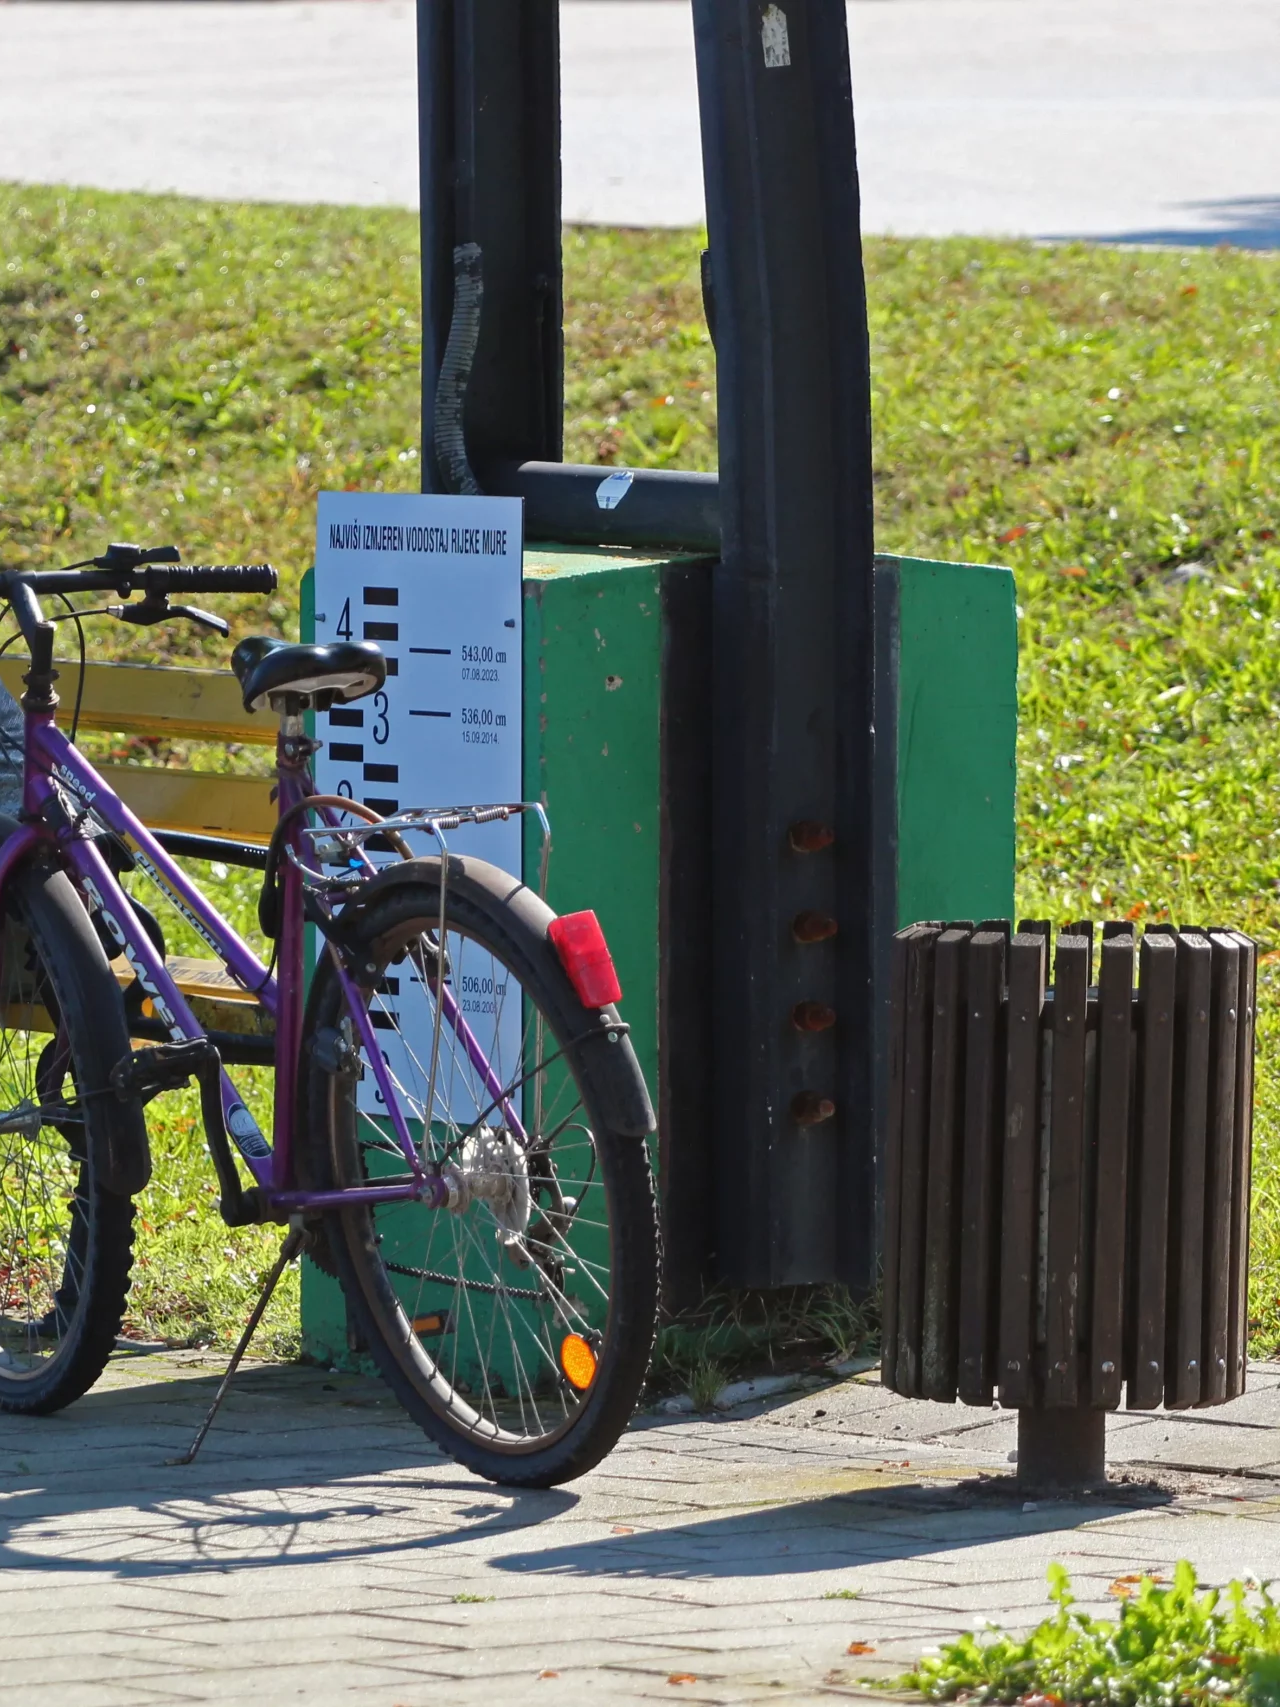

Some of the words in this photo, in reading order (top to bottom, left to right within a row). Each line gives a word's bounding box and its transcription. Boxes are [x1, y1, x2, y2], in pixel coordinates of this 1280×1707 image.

[329, 518, 361, 549] NAJVIŠI
[363, 525, 404, 551] IZMJEREN
[406, 527, 448, 554] VODOSTAJ
[451, 528, 480, 555] RIJEKE
[482, 530, 507, 556] MURE
[336, 597, 353, 641] 4
[461, 645, 493, 666] 543,00
[495, 651, 507, 663] cm
[461, 668, 500, 681] 07.08.2023.
[373, 690, 390, 745] 3
[461, 708, 493, 728] 536,00
[495, 714, 507, 727] cm
[461, 730, 500, 745] 15.09.2014.
[60, 764, 97, 803] speed
[462, 976, 493, 996] 506,00
[495, 984, 507, 997] cm
